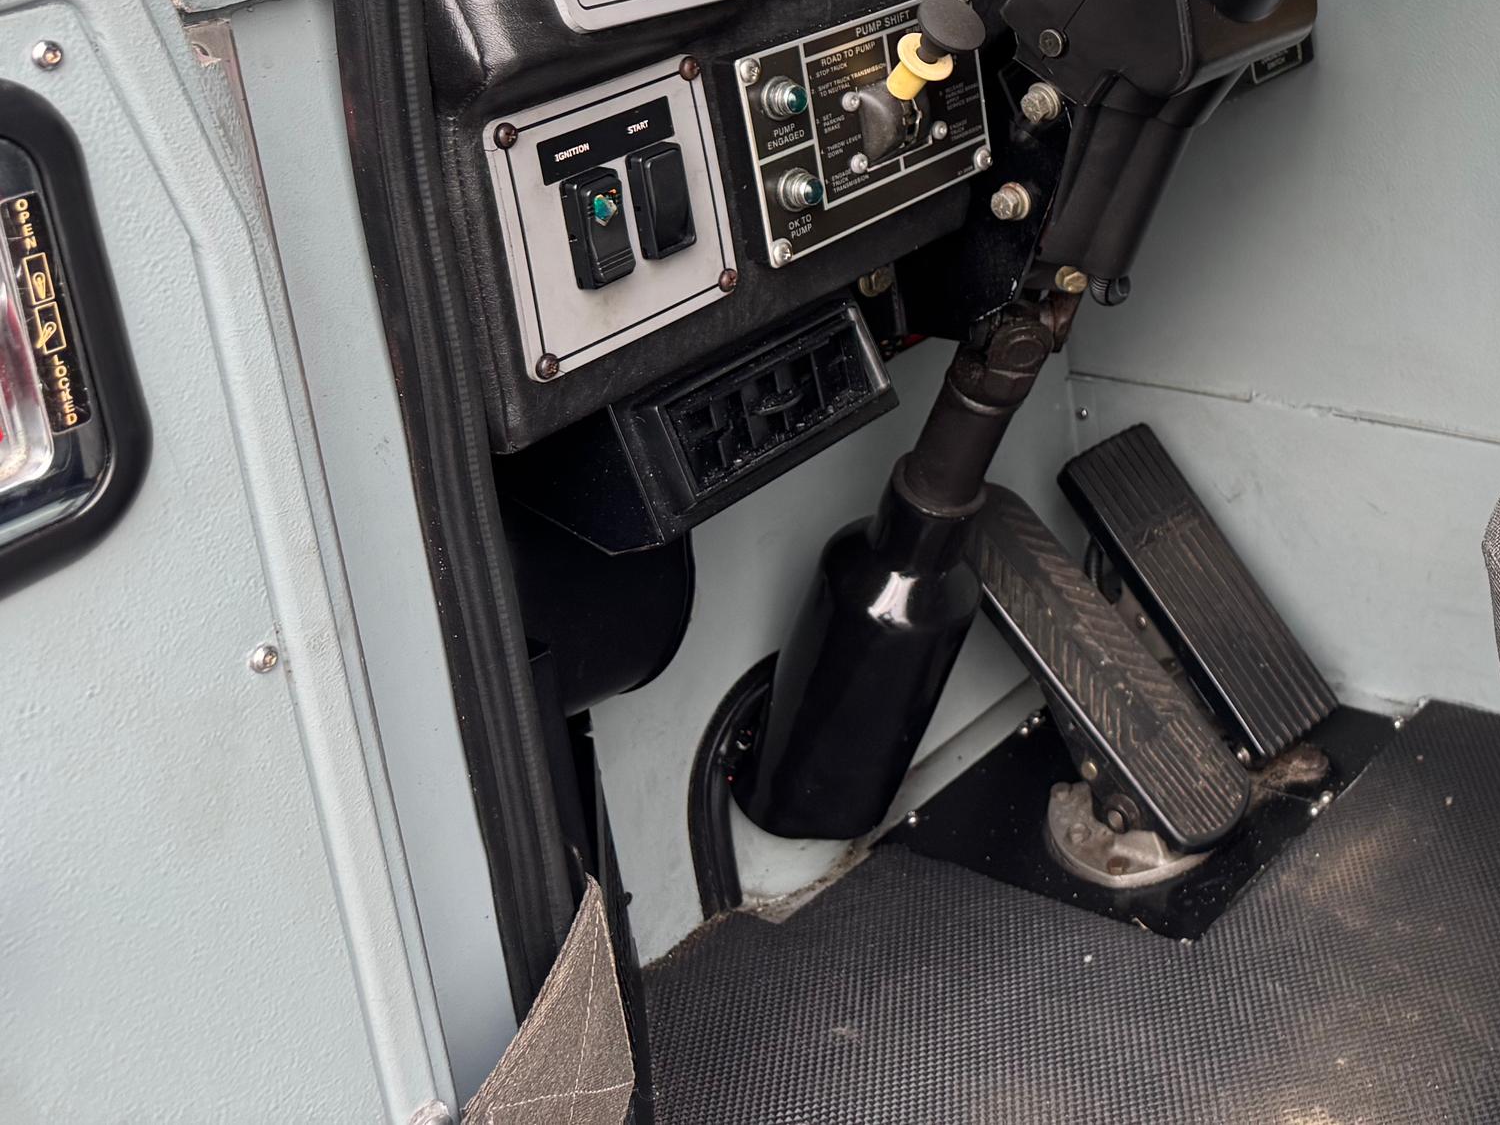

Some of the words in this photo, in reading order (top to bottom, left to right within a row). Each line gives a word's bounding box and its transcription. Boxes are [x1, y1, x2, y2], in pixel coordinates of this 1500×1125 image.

[855, 19, 882, 38] PUMP
[884, 9, 911, 28] SHIFT
[821, 54, 842, 67] ROAD
[844, 49, 854, 58] TO
[855, 41, 877, 56] PUMP
[815, 68, 830, 79] STOP
[831, 62, 848, 73] TRUCK
[829, 82, 851, 95] NEUTRAL
[834, 75, 851, 87] TRUCK
[822, 113, 833, 122] SET
[627, 119, 649, 135] START
[773, 122, 796, 138] PUMP
[767, 129, 805, 151] ENGAGED
[554, 142, 590, 162] IGNITION
[15, 198, 38, 249] OPEN
[788, 217, 801, 231] OK
[801, 214, 813, 223] TO
[791, 224, 813, 239] PUMP
[53, 353, 79, 426] LOCKED
